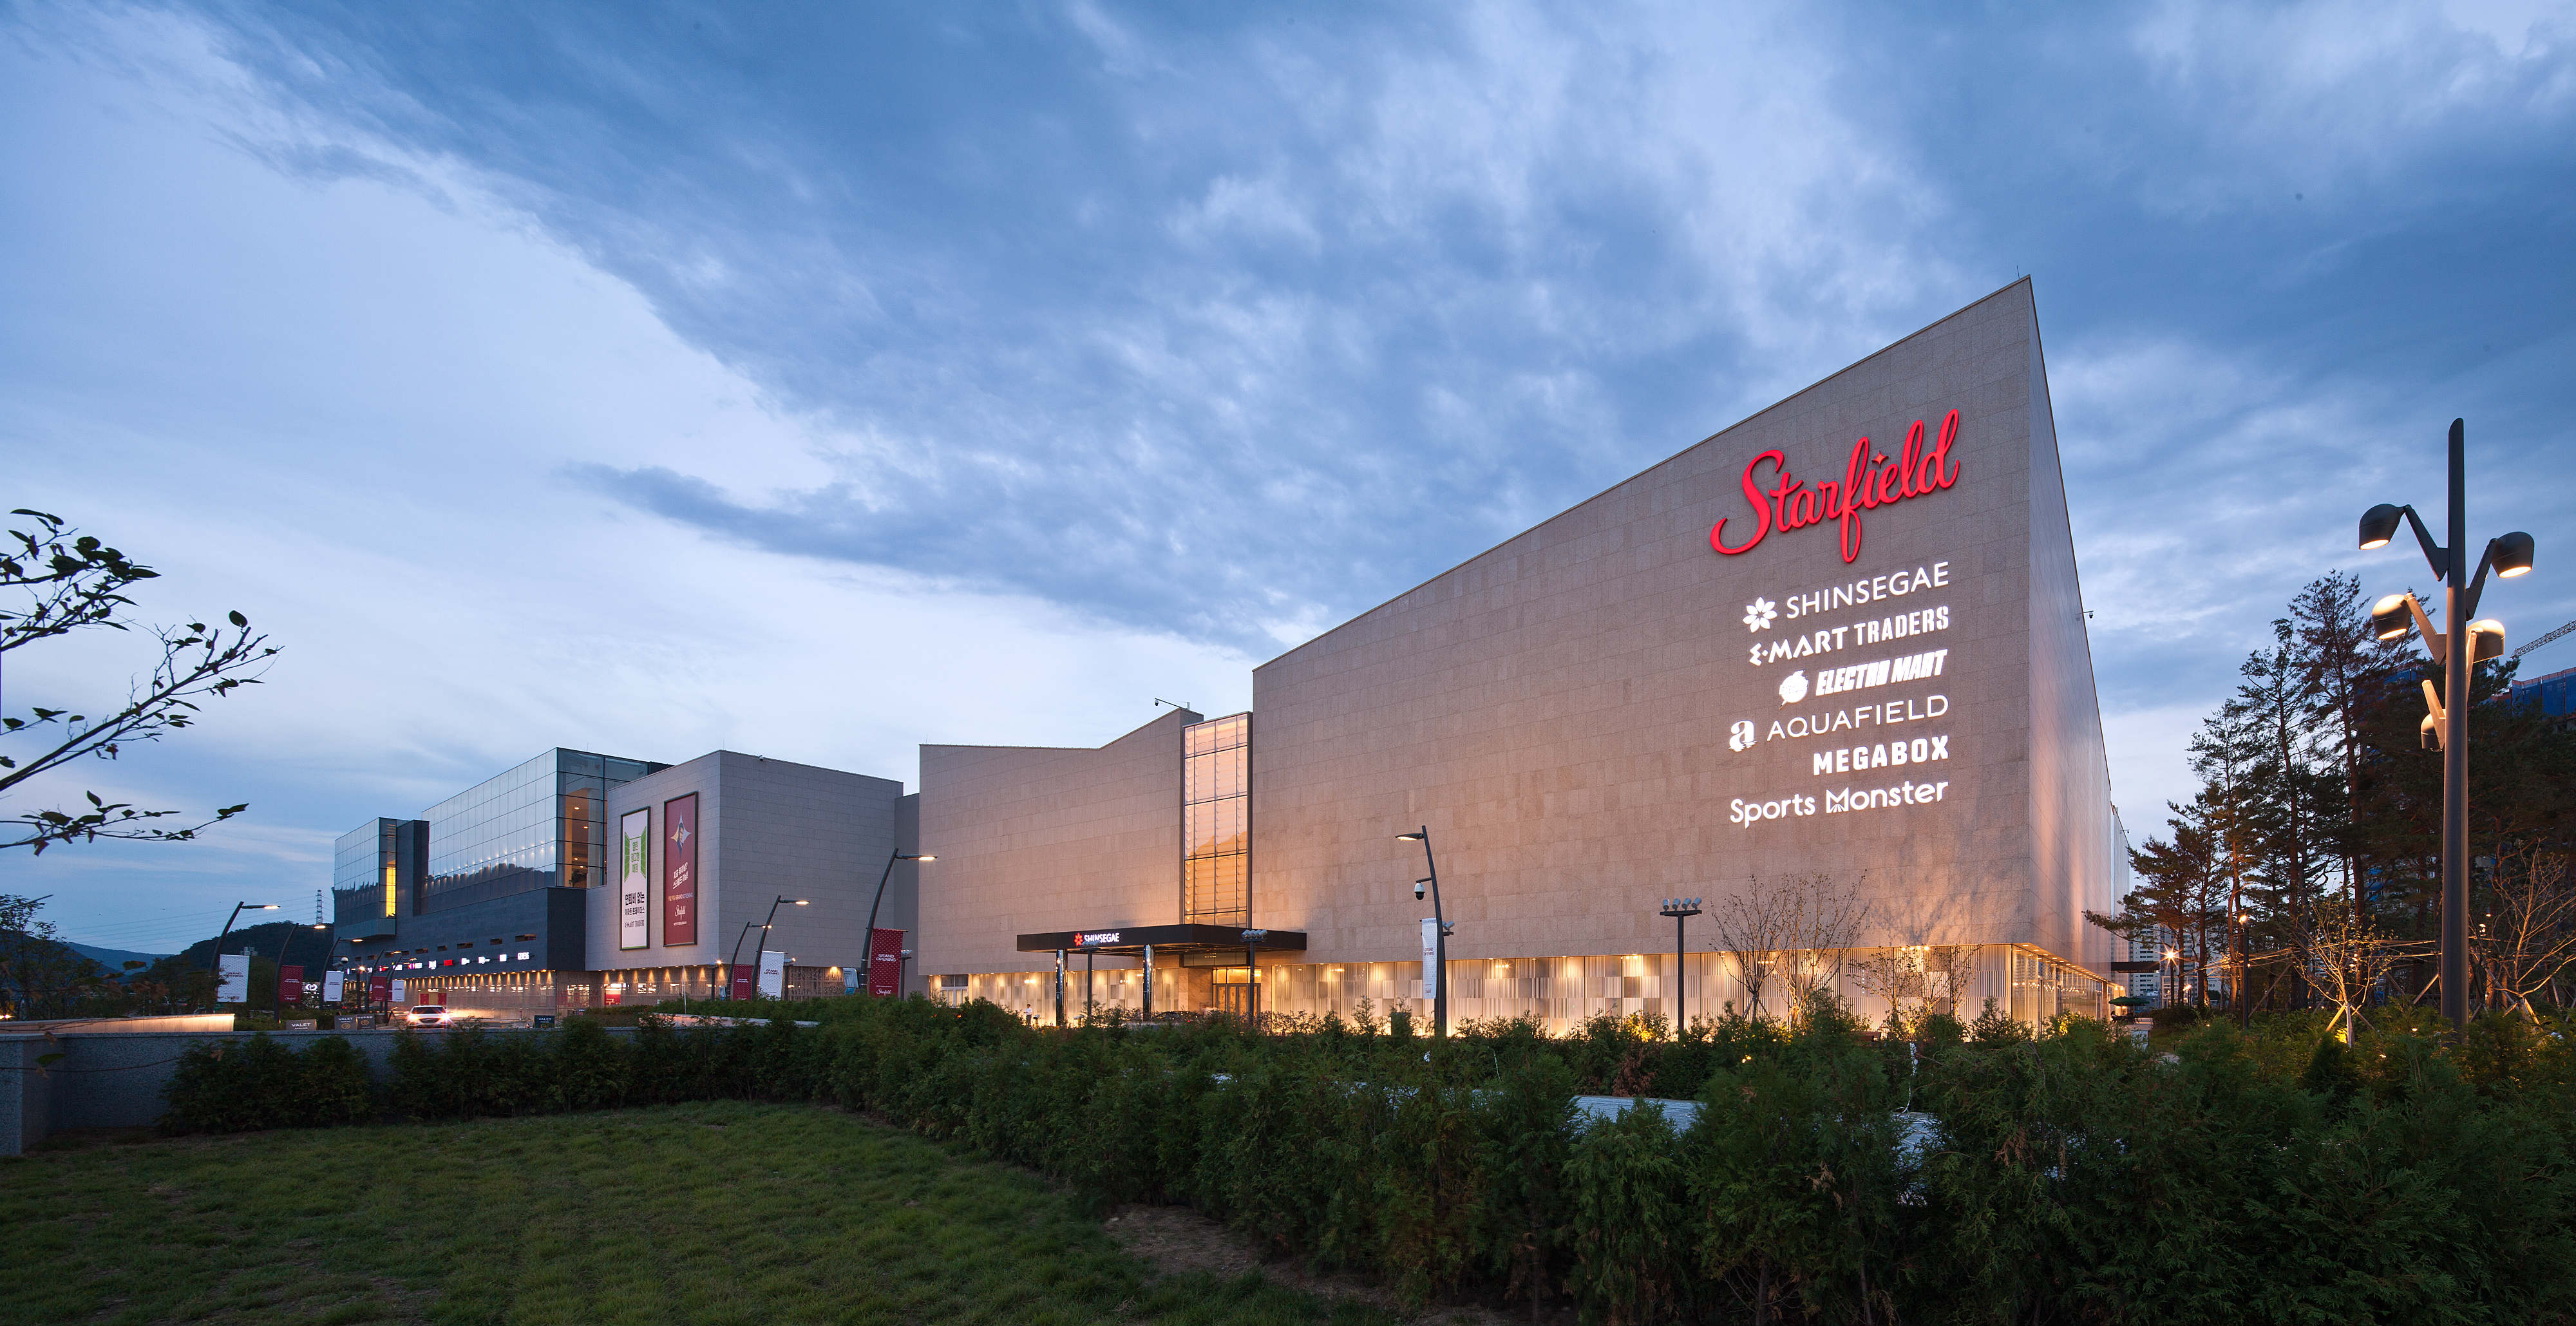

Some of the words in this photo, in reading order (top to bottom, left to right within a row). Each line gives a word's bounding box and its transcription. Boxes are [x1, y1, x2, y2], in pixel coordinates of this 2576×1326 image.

[1710, 408, 1960, 563] Starfield
[1786, 561, 1949, 620] SHINSEGAE
[1853, 605, 1949, 645] TRADERS
[1815, 659, 1891, 696] ELECTRO
[1890, 649, 1948, 683] MART
[1766, 695, 1949, 741] AQUAFIELD
[1814, 735, 1949, 775] MEGABOX
[1730, 793, 1816, 829] Sports
[1826, 781, 1949, 813] Monster
[625, 892, 636, 905] 연회비
[637, 891, 645, 904] 없는
[1084, 933, 1120, 943] SHINSEGAE
